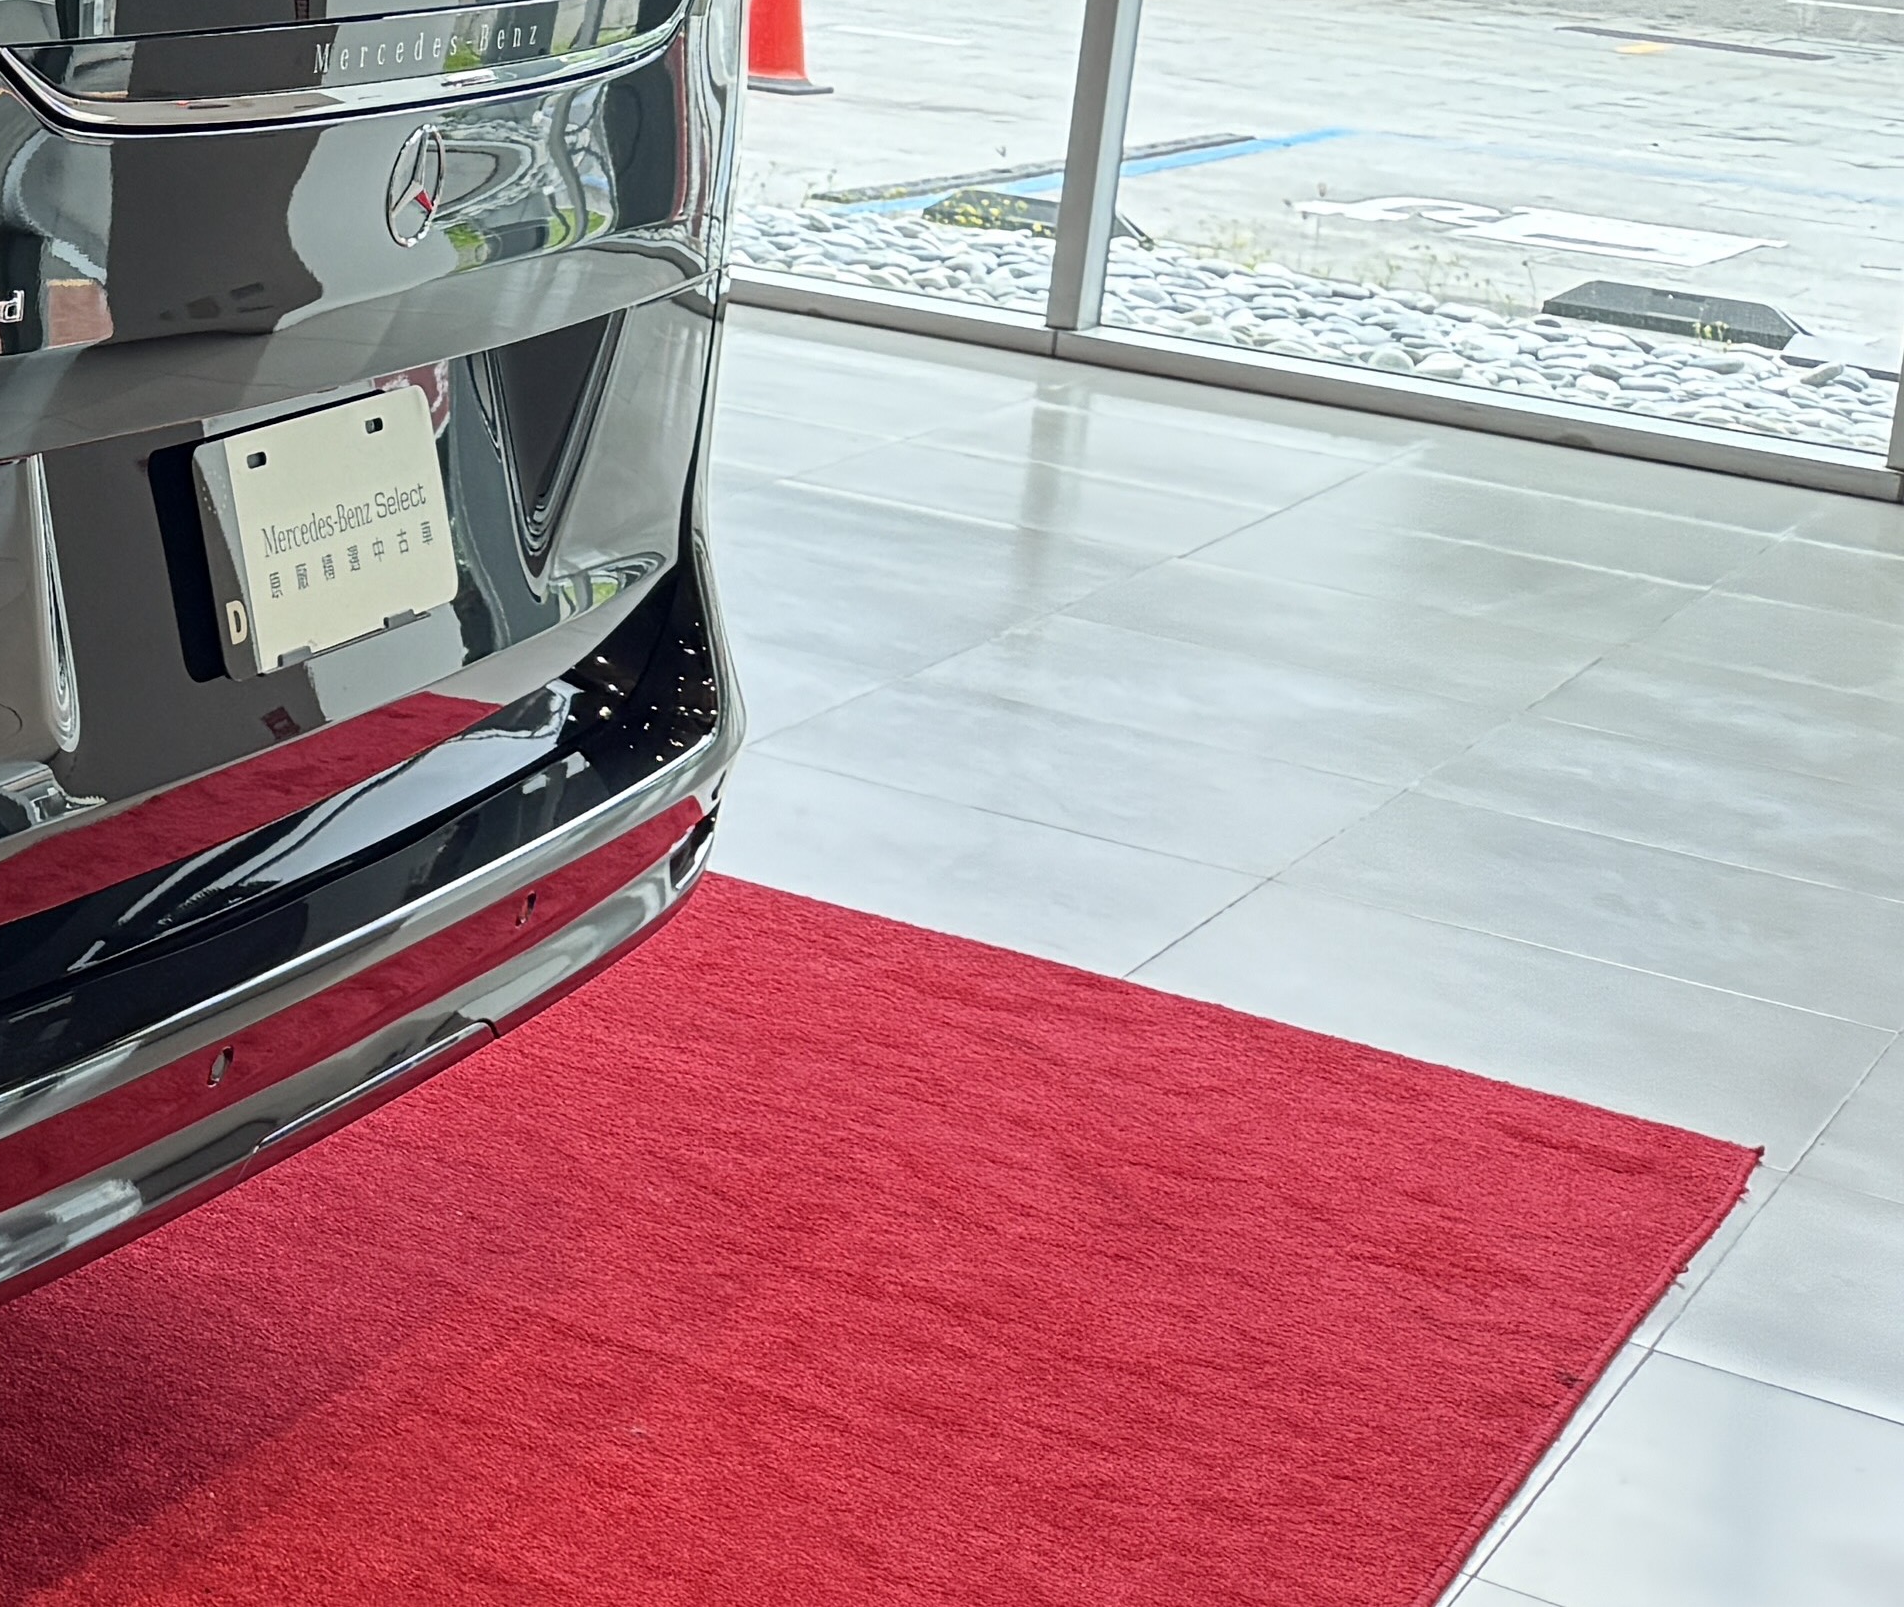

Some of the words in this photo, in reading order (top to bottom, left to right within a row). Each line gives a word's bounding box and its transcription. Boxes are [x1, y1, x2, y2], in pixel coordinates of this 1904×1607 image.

[313, 23, 539, 74] Mercedes-Benz
[261, 500, 373, 559] Mercedes-Benz
[374, 482, 427, 519] Select
